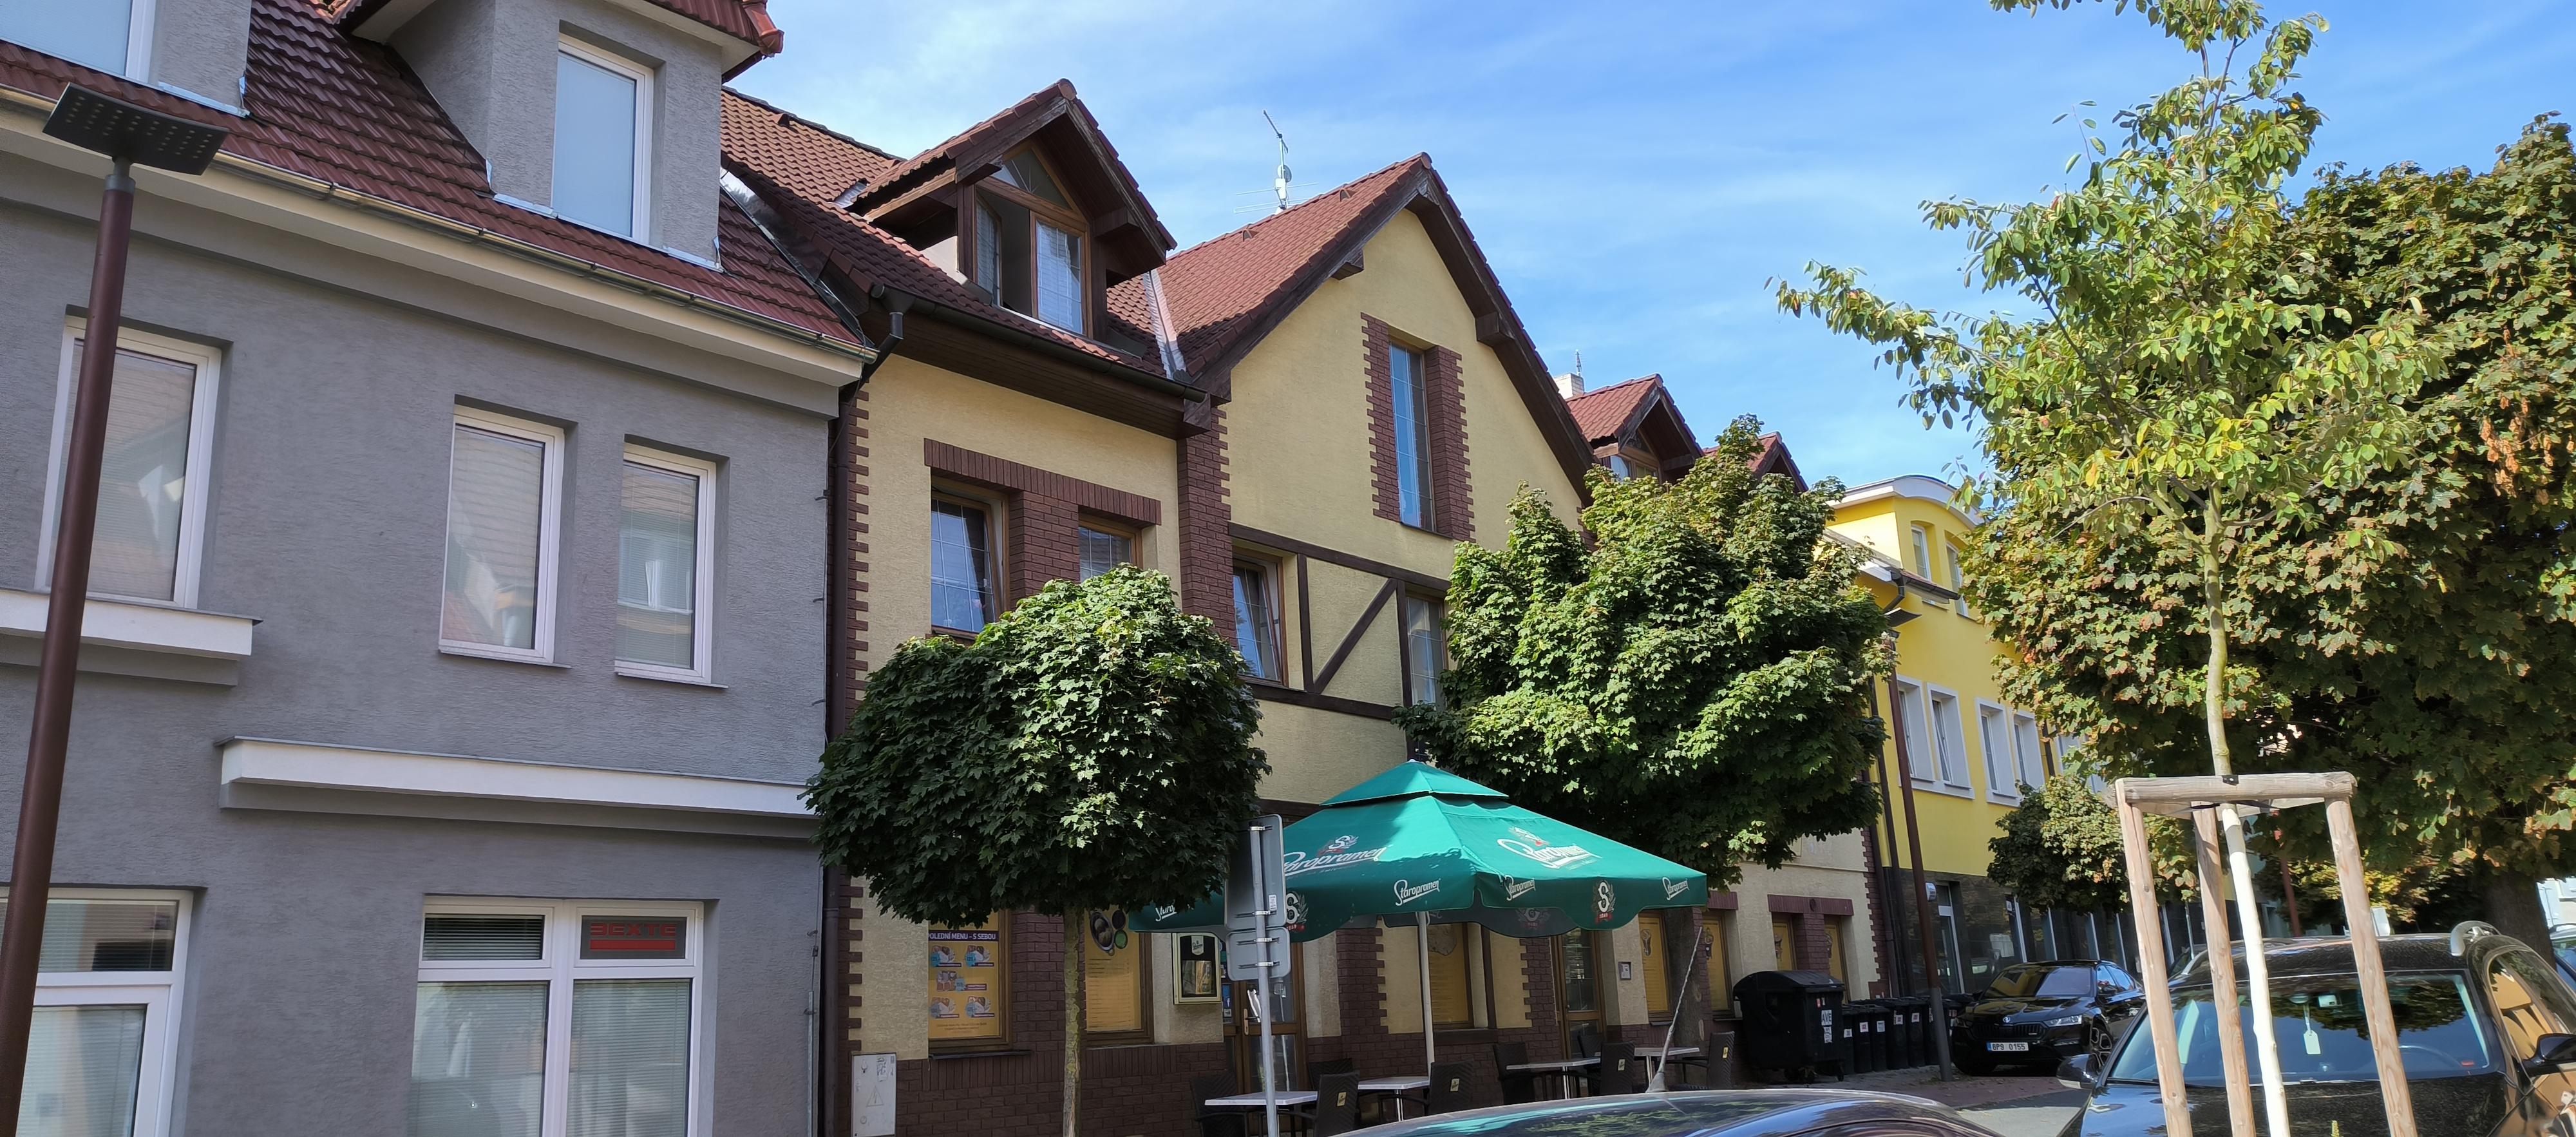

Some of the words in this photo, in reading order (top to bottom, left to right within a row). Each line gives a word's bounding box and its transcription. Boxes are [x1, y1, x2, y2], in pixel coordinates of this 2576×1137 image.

[1394, 879, 1441, 906] Staropramen
[1504, 874, 1537, 901] Staropramen
[1662, 877, 1690, 901] Staropramen
